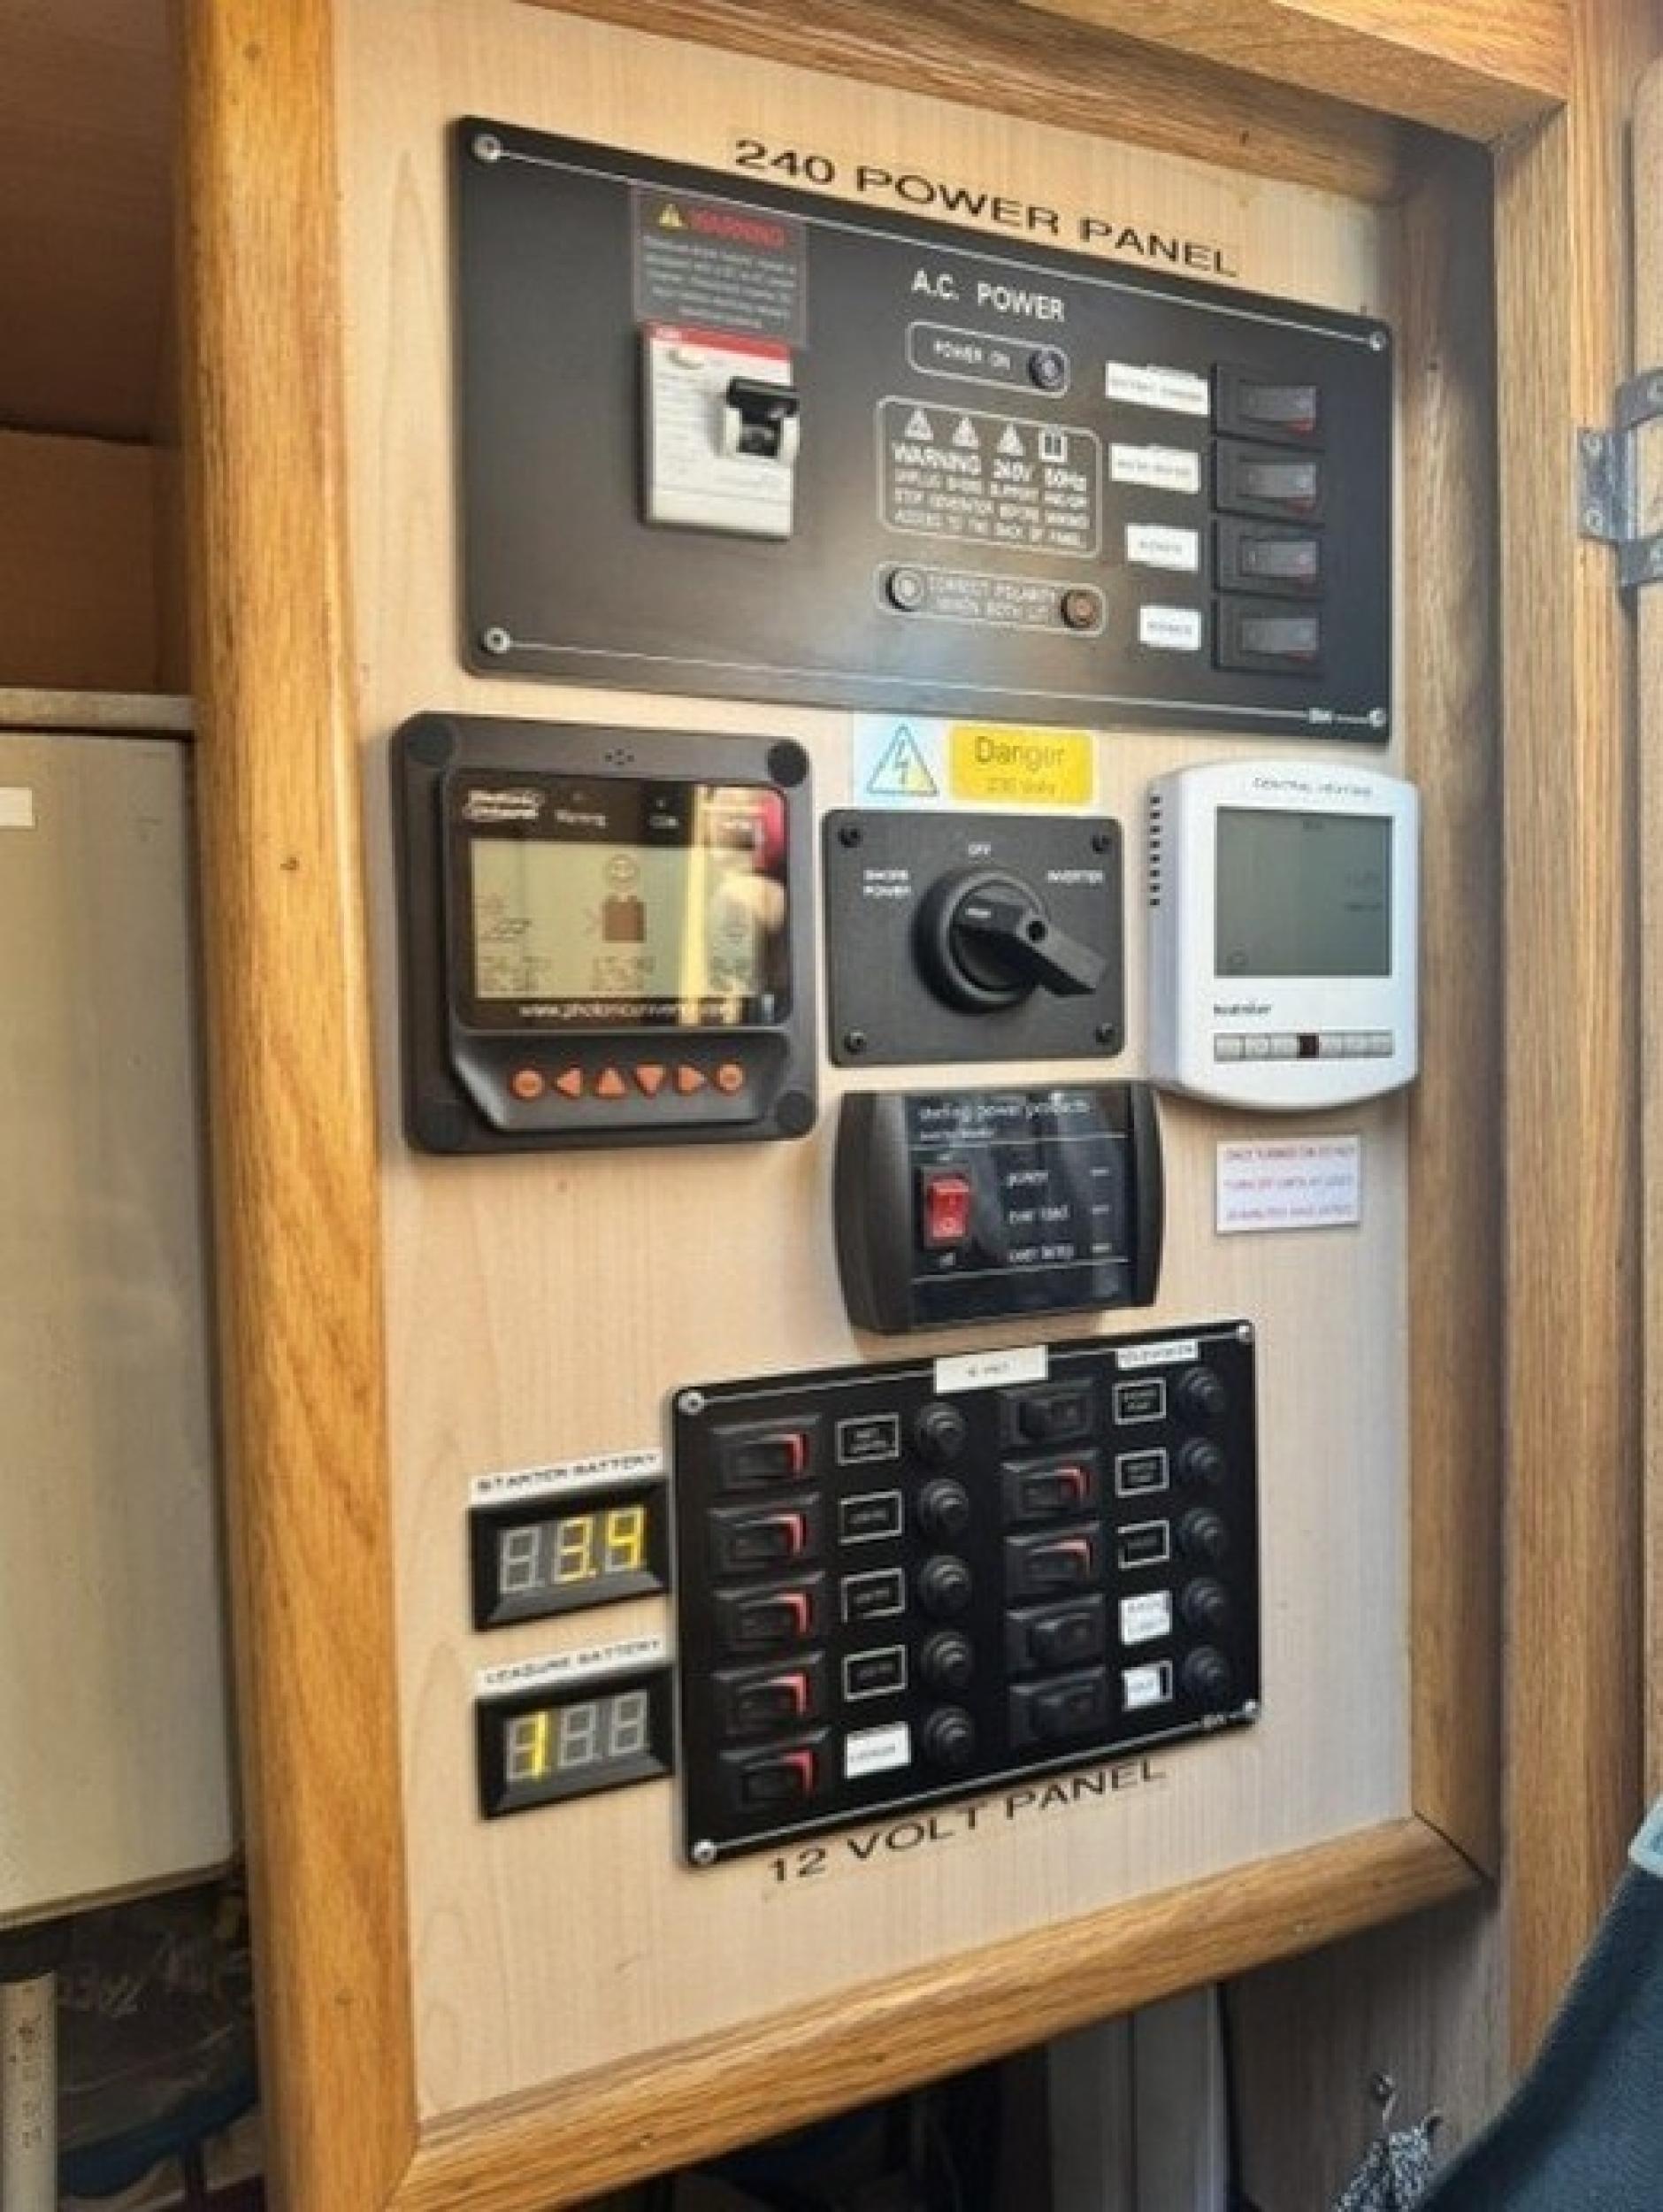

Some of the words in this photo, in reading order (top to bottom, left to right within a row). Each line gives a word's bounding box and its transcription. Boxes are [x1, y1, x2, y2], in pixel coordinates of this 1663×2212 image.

[735, 139, 835, 185] 240
[855, 165, 1060, 234] POWER
[1079, 217, 1238, 278] PANEL
[911, 268, 960, 301] A.C.
[977, 280, 1065, 323] POWER
[892, 442, 982, 476] WARNING
[770, 1847, 827, 1882] 12
[847, 1801, 990, 1860] VOLT
[1004, 1756, 1167, 1820] PANEL
